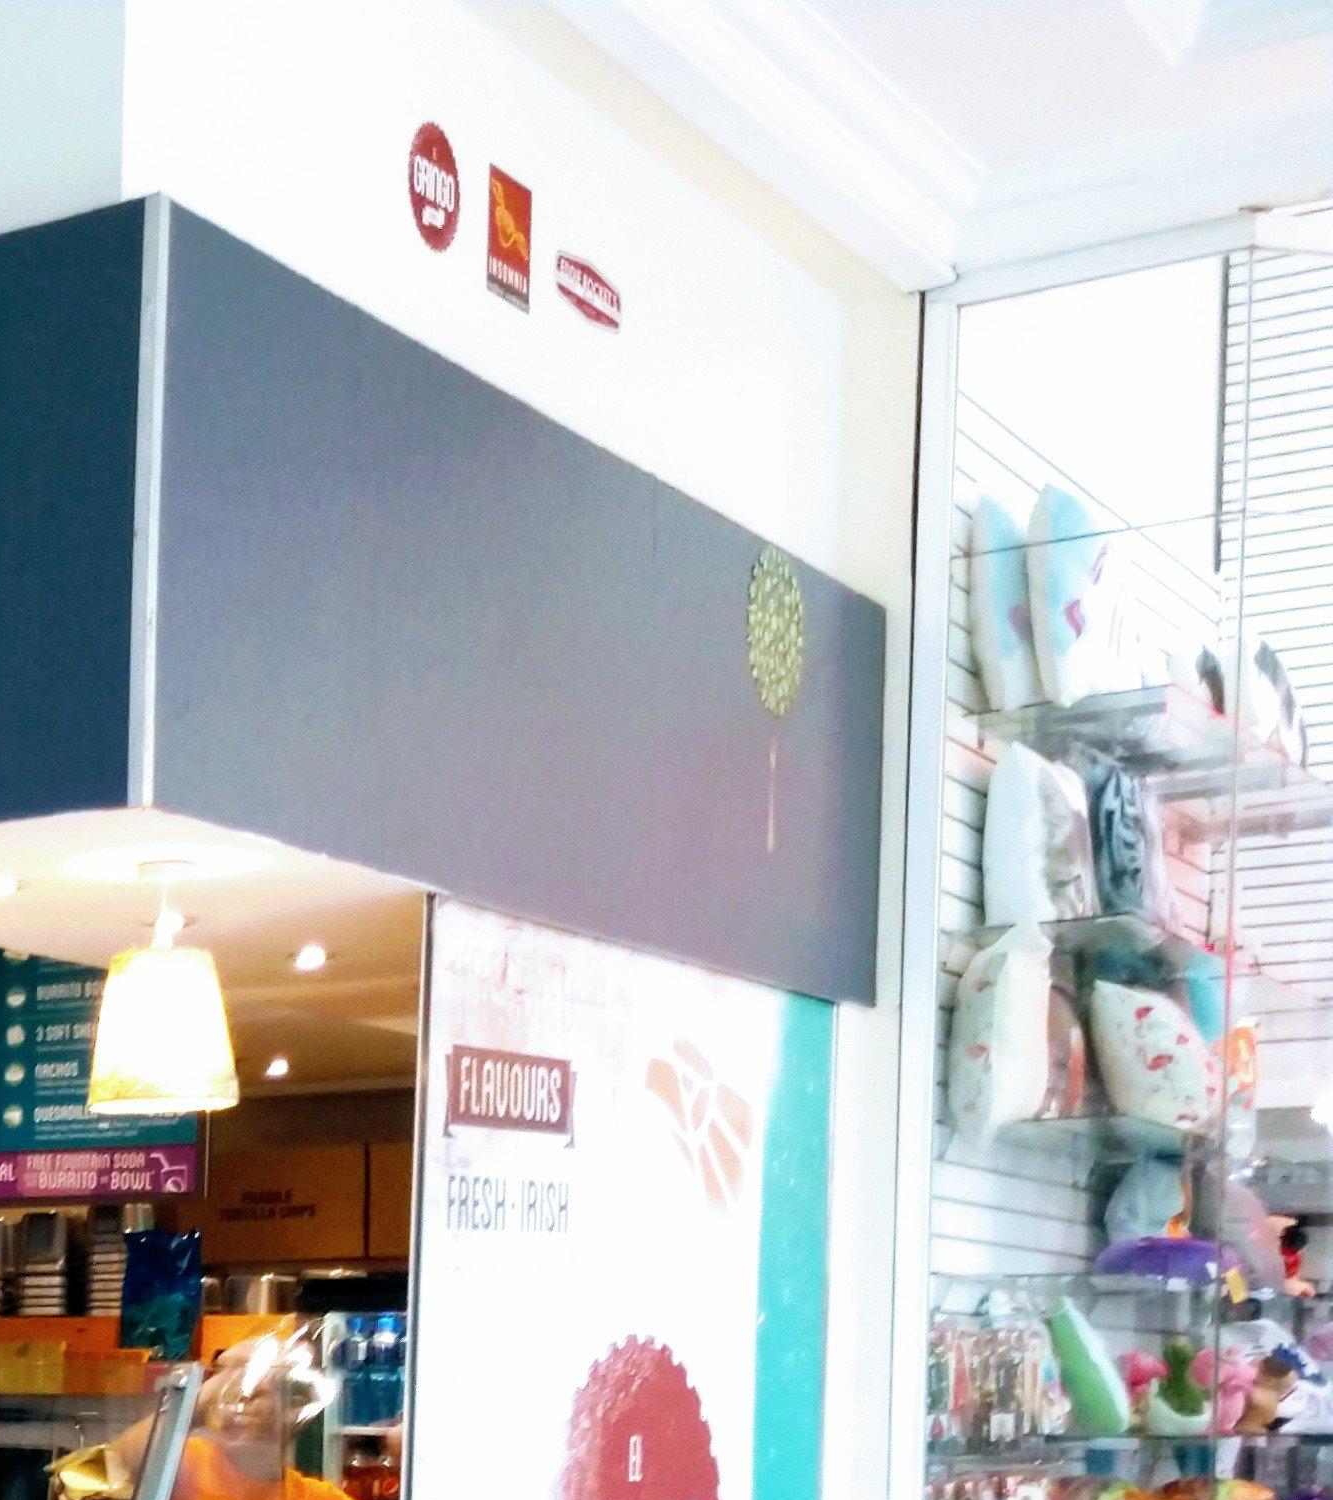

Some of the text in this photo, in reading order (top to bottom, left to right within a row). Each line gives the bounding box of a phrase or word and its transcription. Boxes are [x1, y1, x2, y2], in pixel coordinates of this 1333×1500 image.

[459, 1056, 563, 1123] FLAVOURS
[38, 1169, 154, 1191] BURRITO BOWL
[113, 1152, 146, 1168] SODA
[447, 1175, 570, 1233] FRESH IRISH
